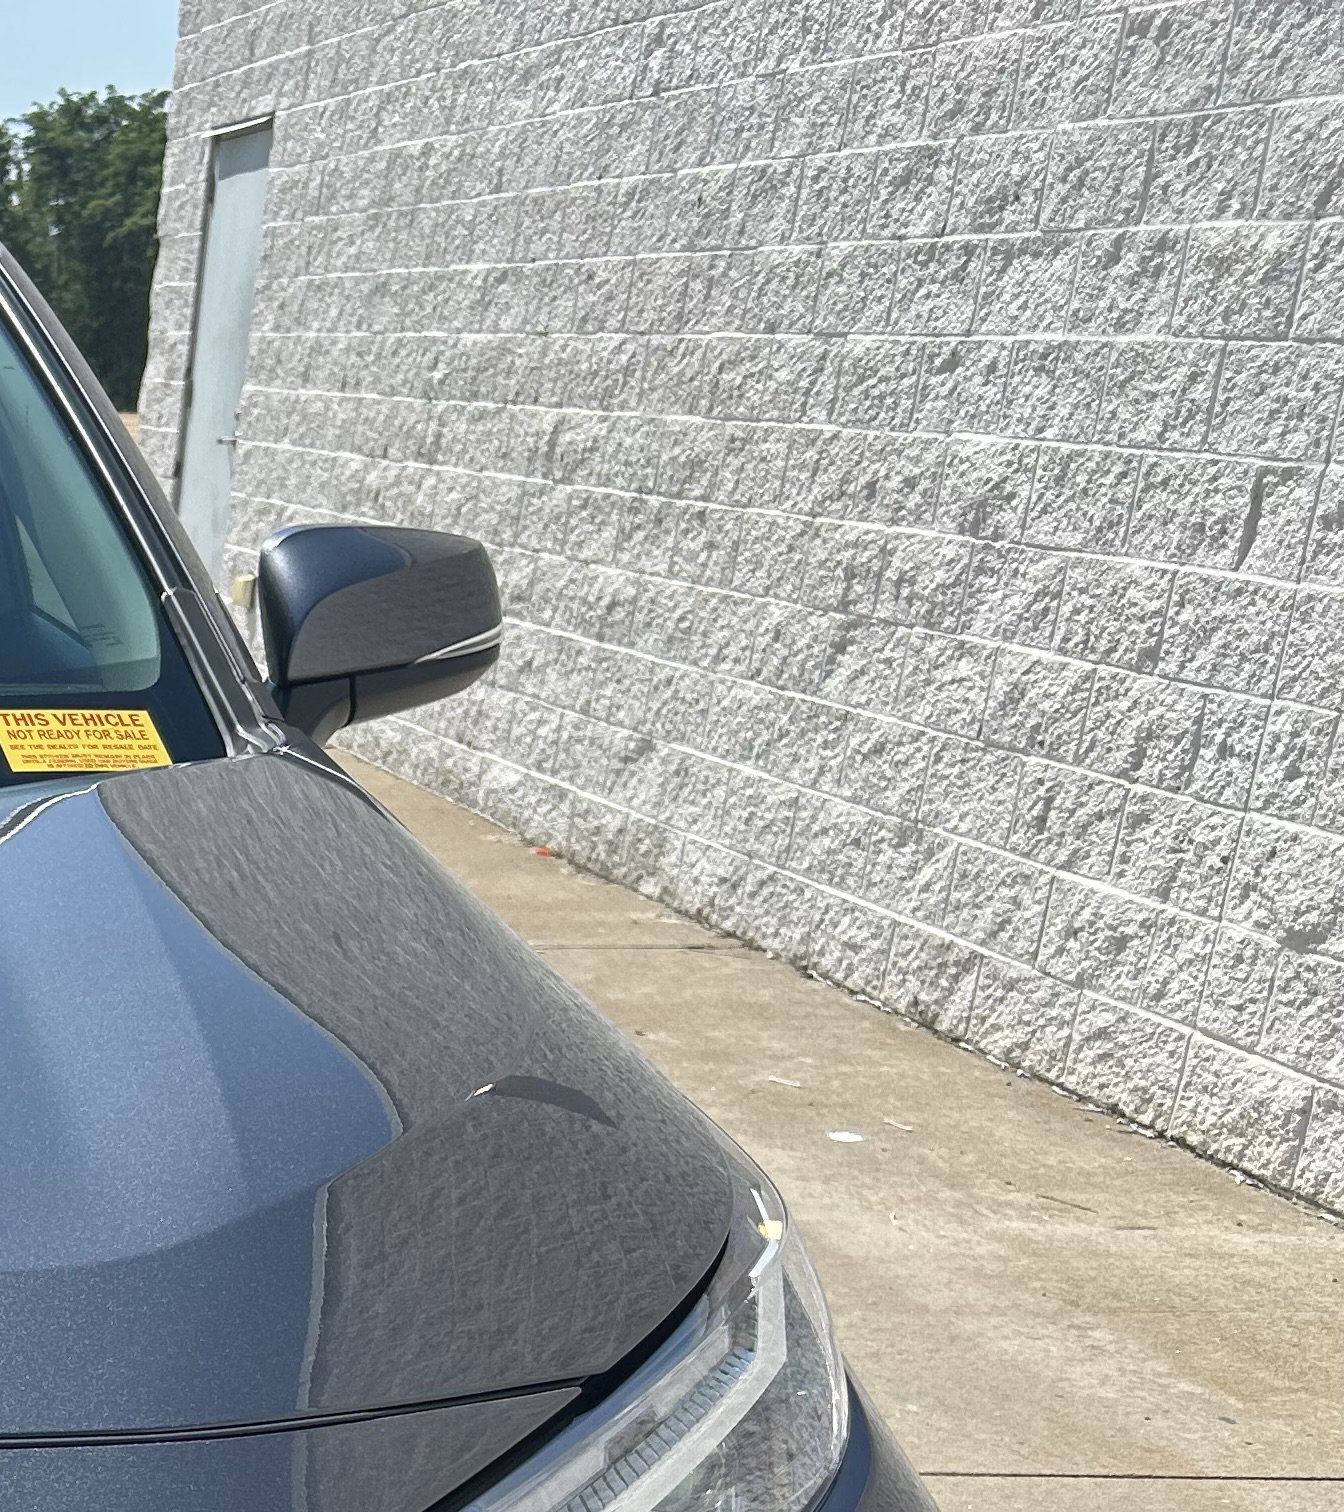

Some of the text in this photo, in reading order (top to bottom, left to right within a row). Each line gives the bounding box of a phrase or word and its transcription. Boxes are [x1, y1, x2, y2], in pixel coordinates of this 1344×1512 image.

[52, 713, 145, 727] VEHICLE
[6, 729, 150, 741] NOT READY FOR SALE
